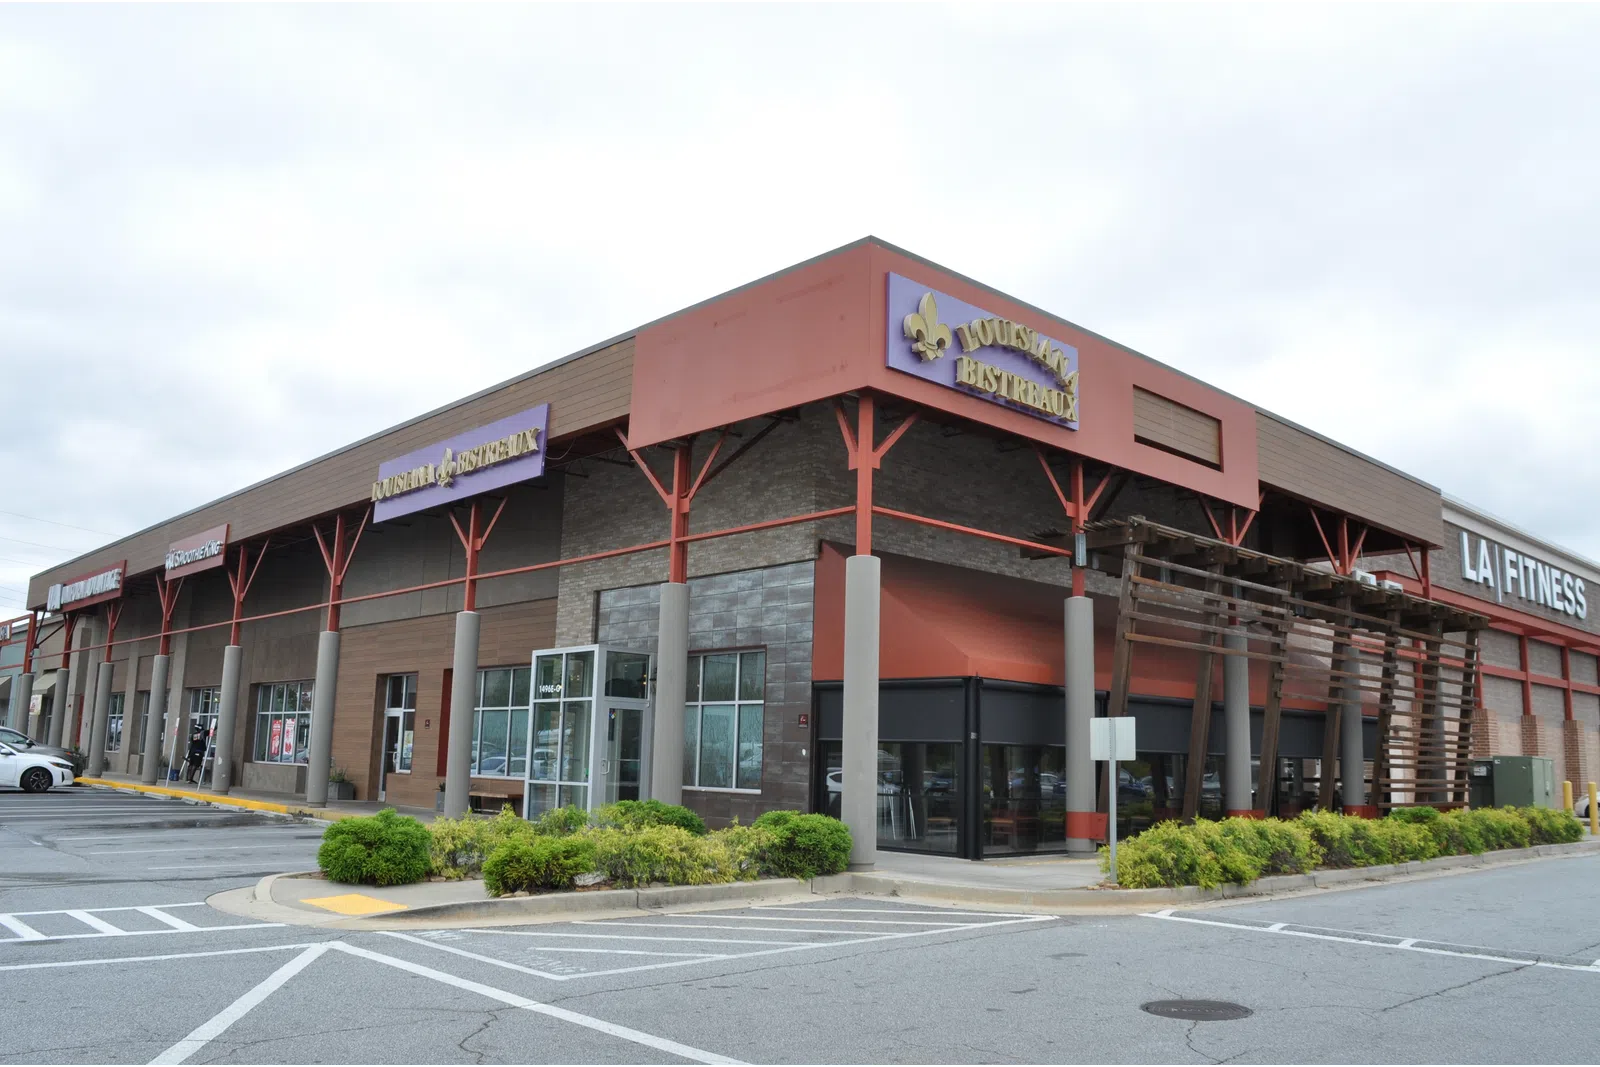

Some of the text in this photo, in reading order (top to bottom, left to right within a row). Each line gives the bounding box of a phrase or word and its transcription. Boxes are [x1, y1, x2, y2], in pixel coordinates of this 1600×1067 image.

[955, 317, 1079, 394] LOUISIANA
[955, 355, 1078, 422] BISTREAUX
[371, 427, 541, 502] LOUISIANA BISTREAUX
[1460, 531, 1587, 620] LA FITNESS
